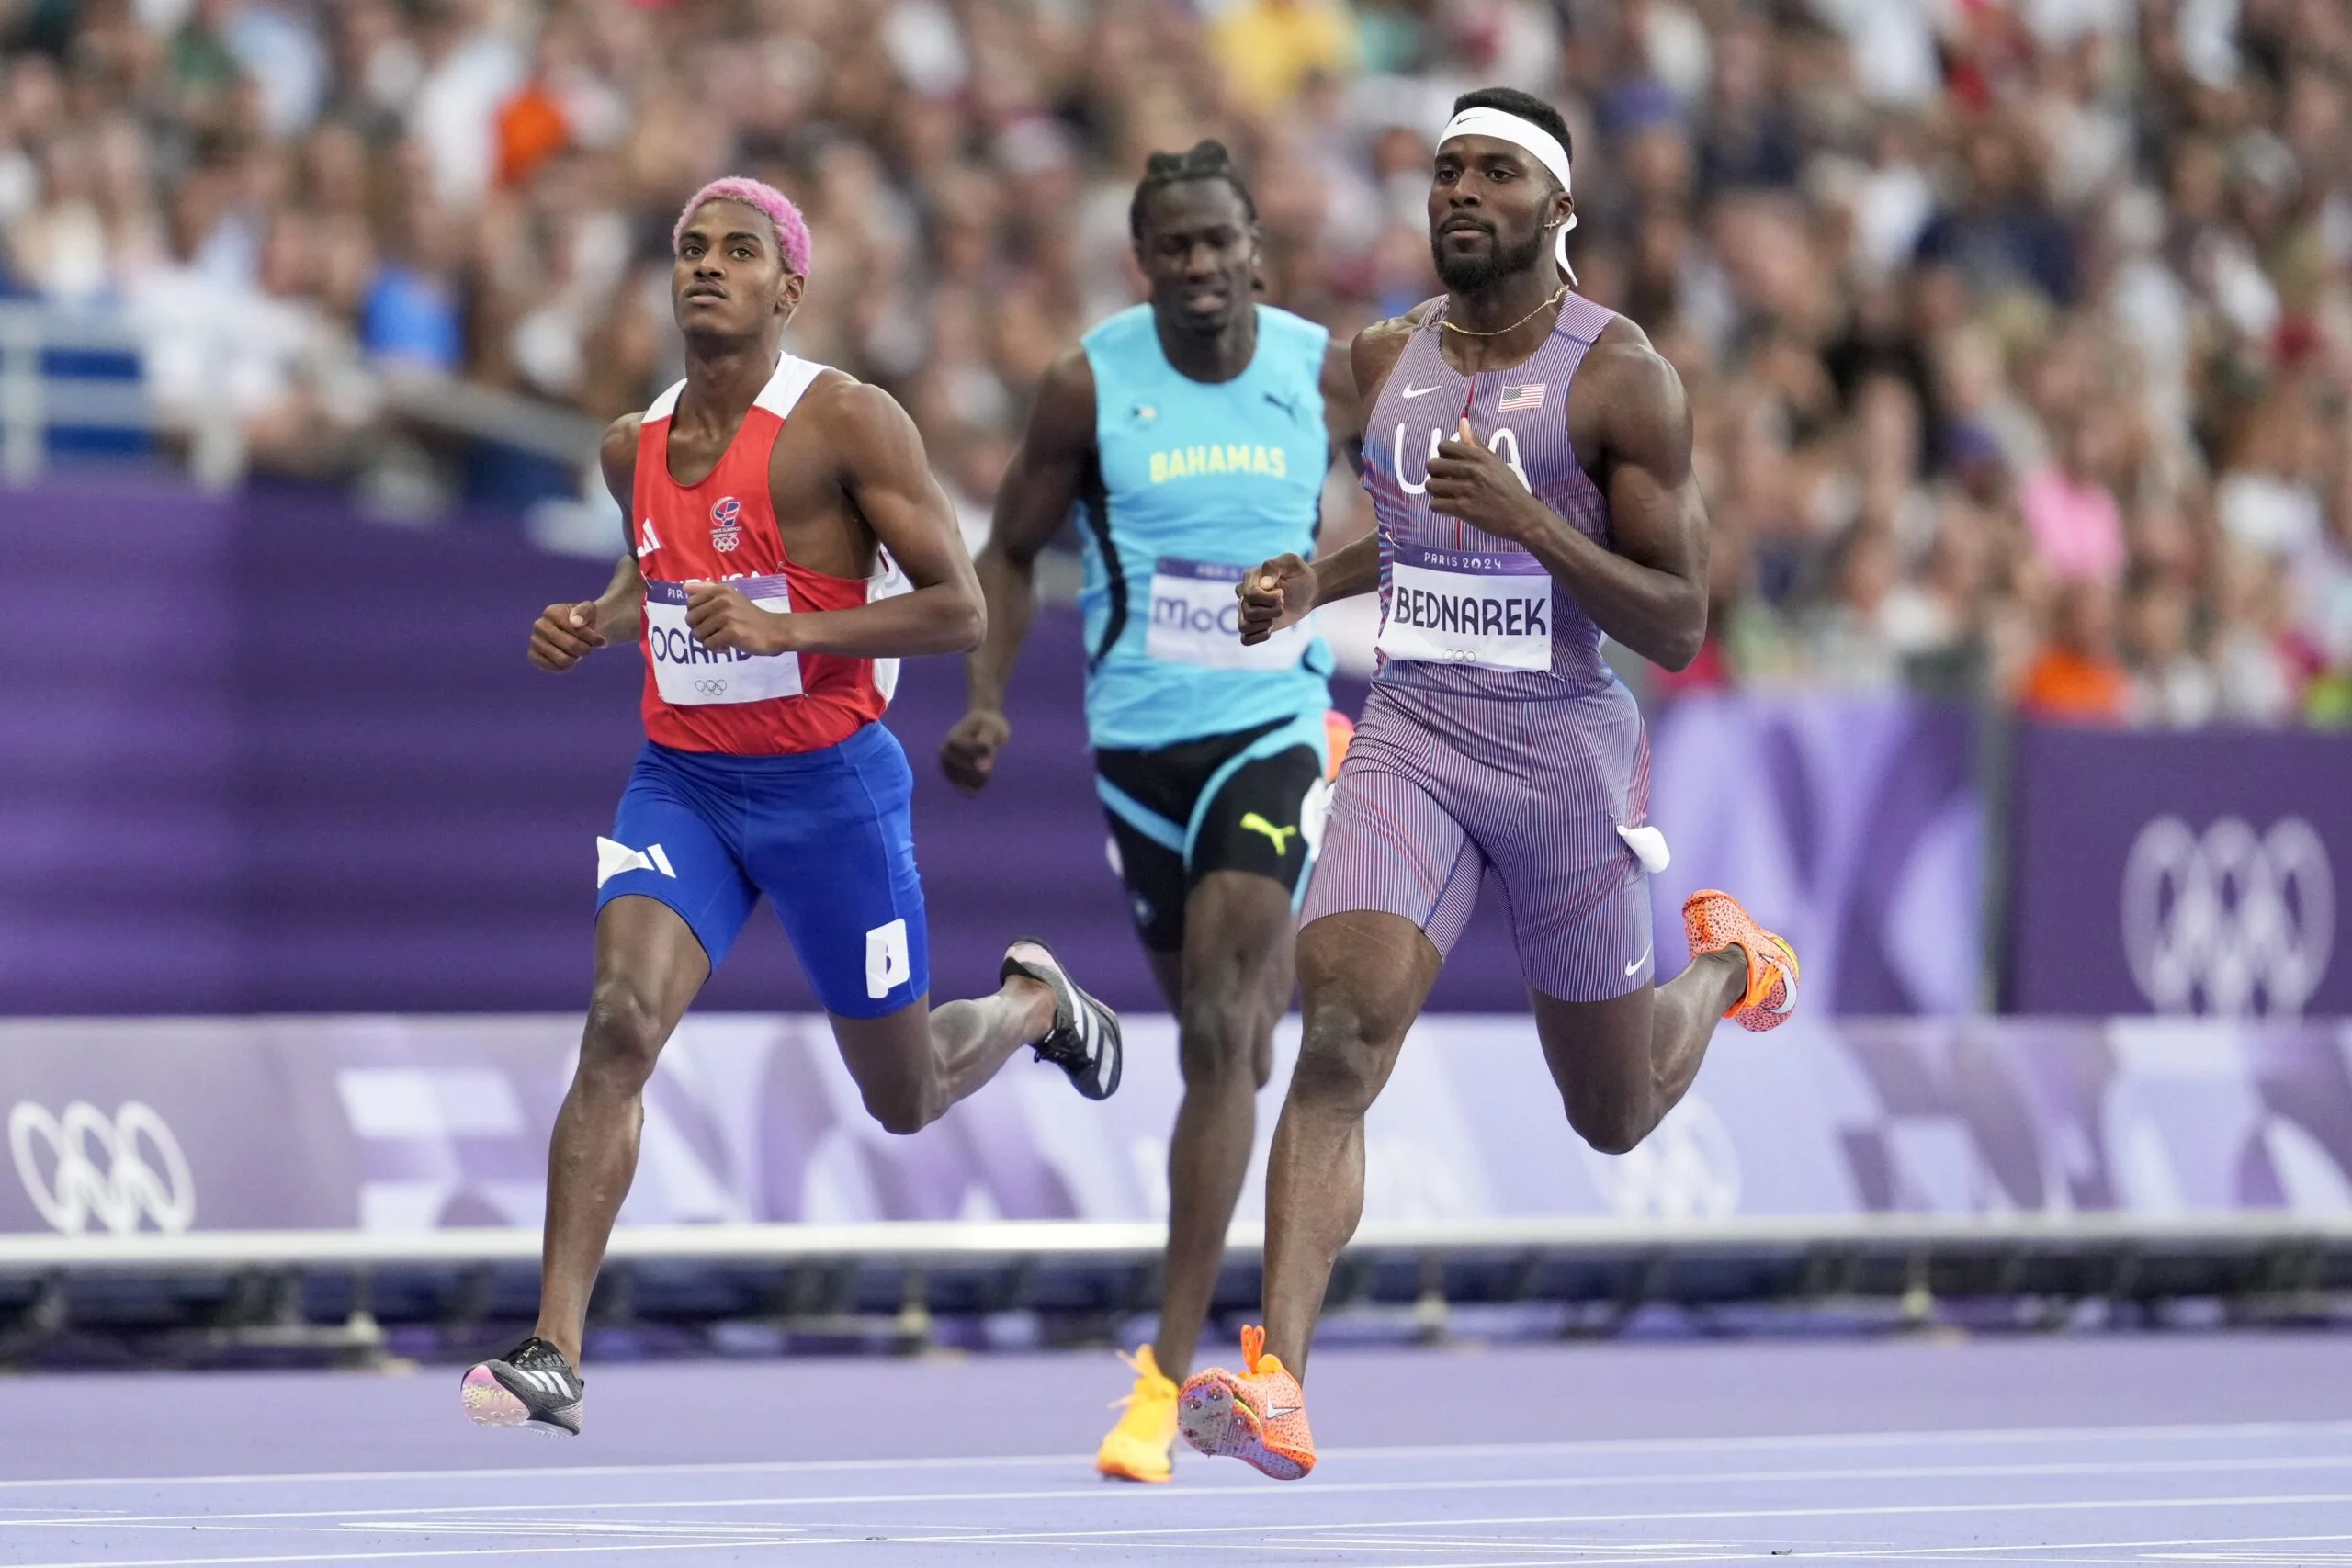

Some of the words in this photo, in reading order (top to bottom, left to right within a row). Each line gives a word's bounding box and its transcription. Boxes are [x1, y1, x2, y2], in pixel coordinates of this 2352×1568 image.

[1149, 443, 1287, 485] BAHAMAS
[1394, 423, 1533, 494] UA
[1424, 551, 1458, 567] PARIS
[1462, 557, 1502, 570] 2024
[1394, 586, 1547, 636] BEDNAREK
